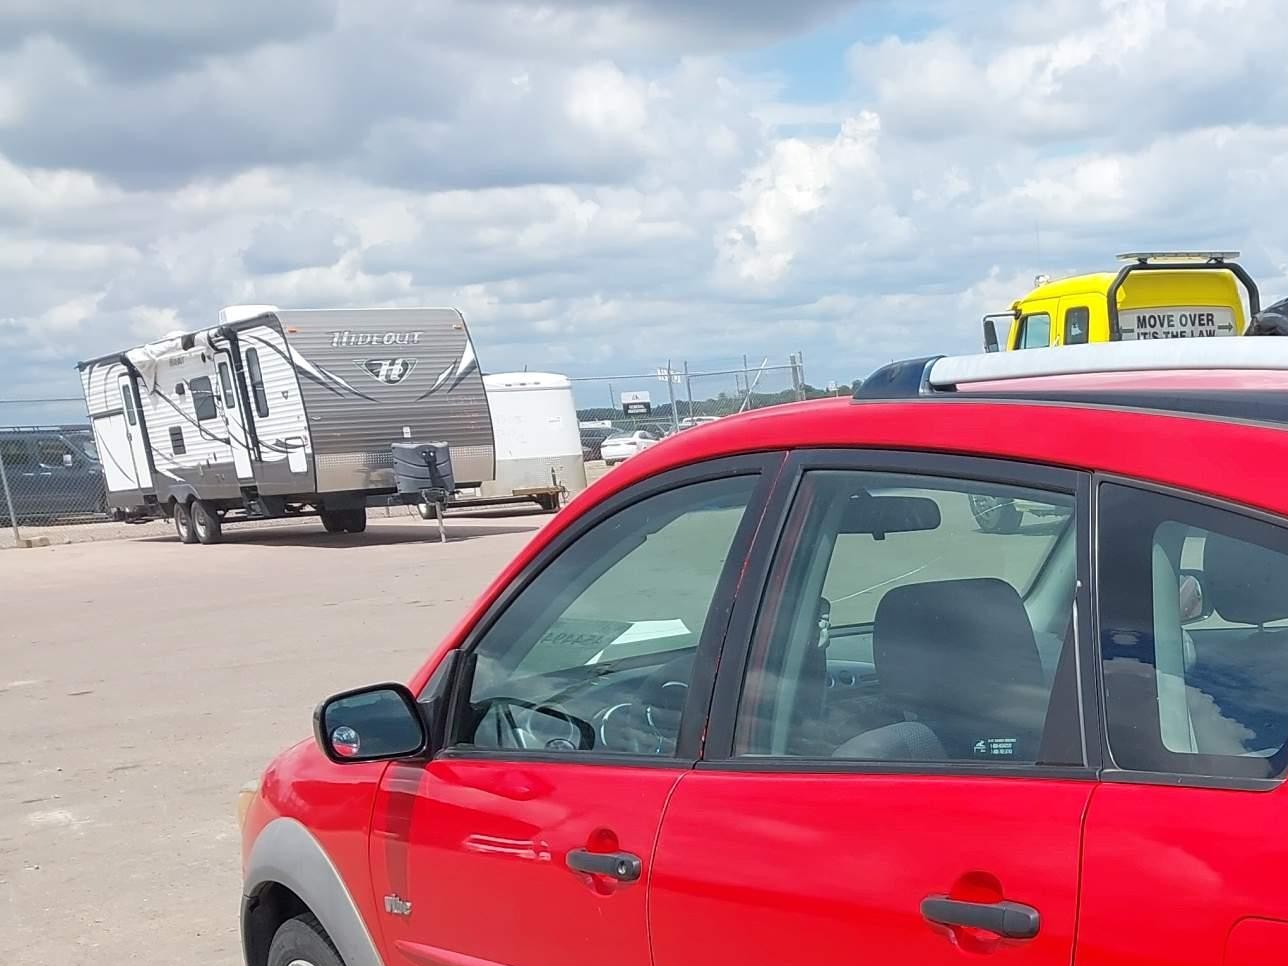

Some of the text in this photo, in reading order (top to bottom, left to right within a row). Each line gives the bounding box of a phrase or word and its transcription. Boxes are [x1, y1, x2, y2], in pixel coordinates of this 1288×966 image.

[1136, 313, 1215, 328] MOVE OVER
[1137, 329, 1216, 340] IT'S THE LAW
